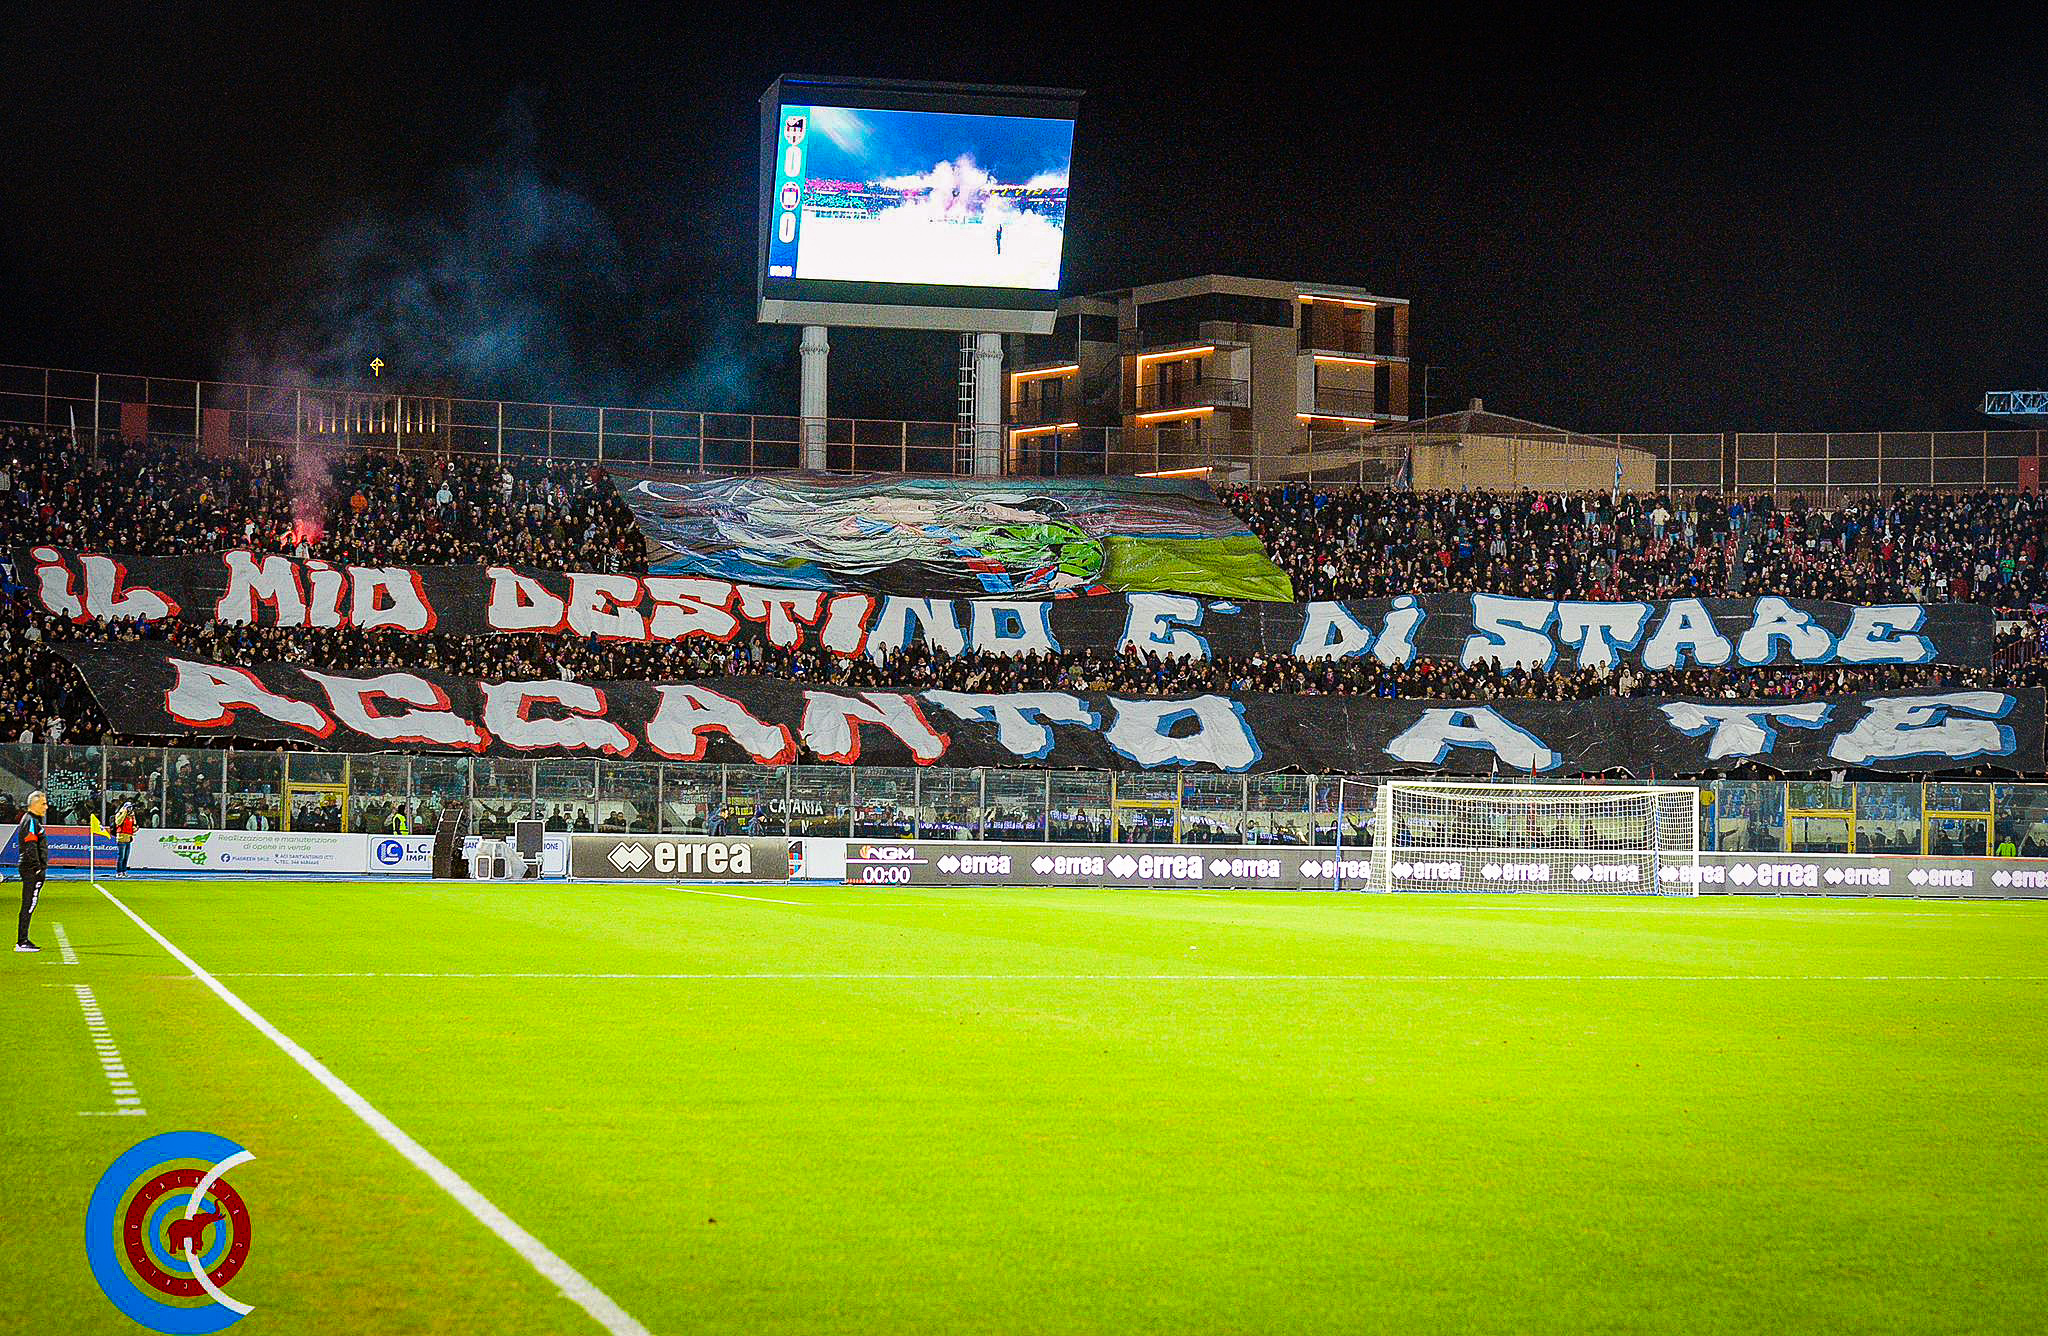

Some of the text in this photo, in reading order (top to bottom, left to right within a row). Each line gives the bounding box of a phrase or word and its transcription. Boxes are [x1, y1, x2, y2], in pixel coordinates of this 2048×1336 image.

[1459, 593, 1938, 674] STARE
[165, 657, 2018, 774] ACCANTO A TE
[862, 865, 911, 883] 00:00
